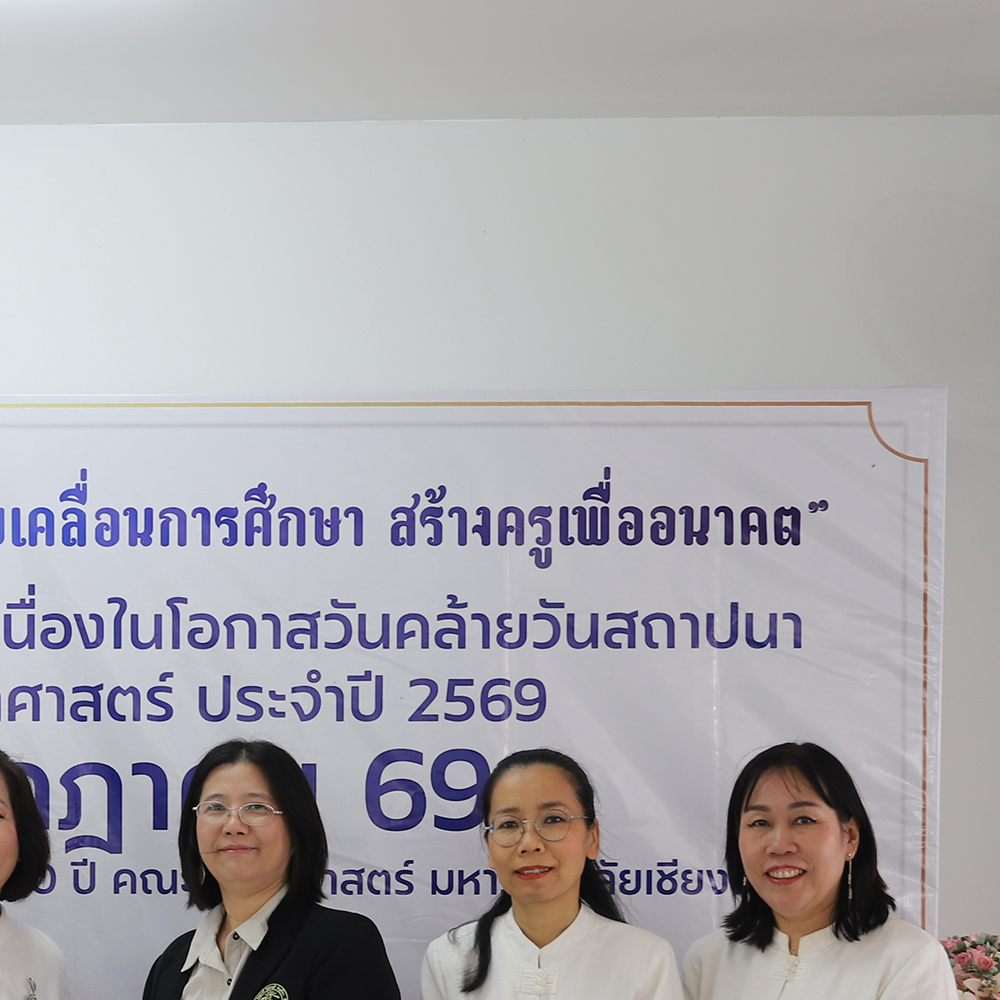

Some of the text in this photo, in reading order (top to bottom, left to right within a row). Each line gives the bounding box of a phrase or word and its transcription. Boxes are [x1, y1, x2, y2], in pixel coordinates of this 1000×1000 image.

[198, 669, 384, 722] ประจำปี
[408, 677, 547, 722] 2569
[365, 748, 491, 832] 69
[70, 858, 96, 895] ปี
